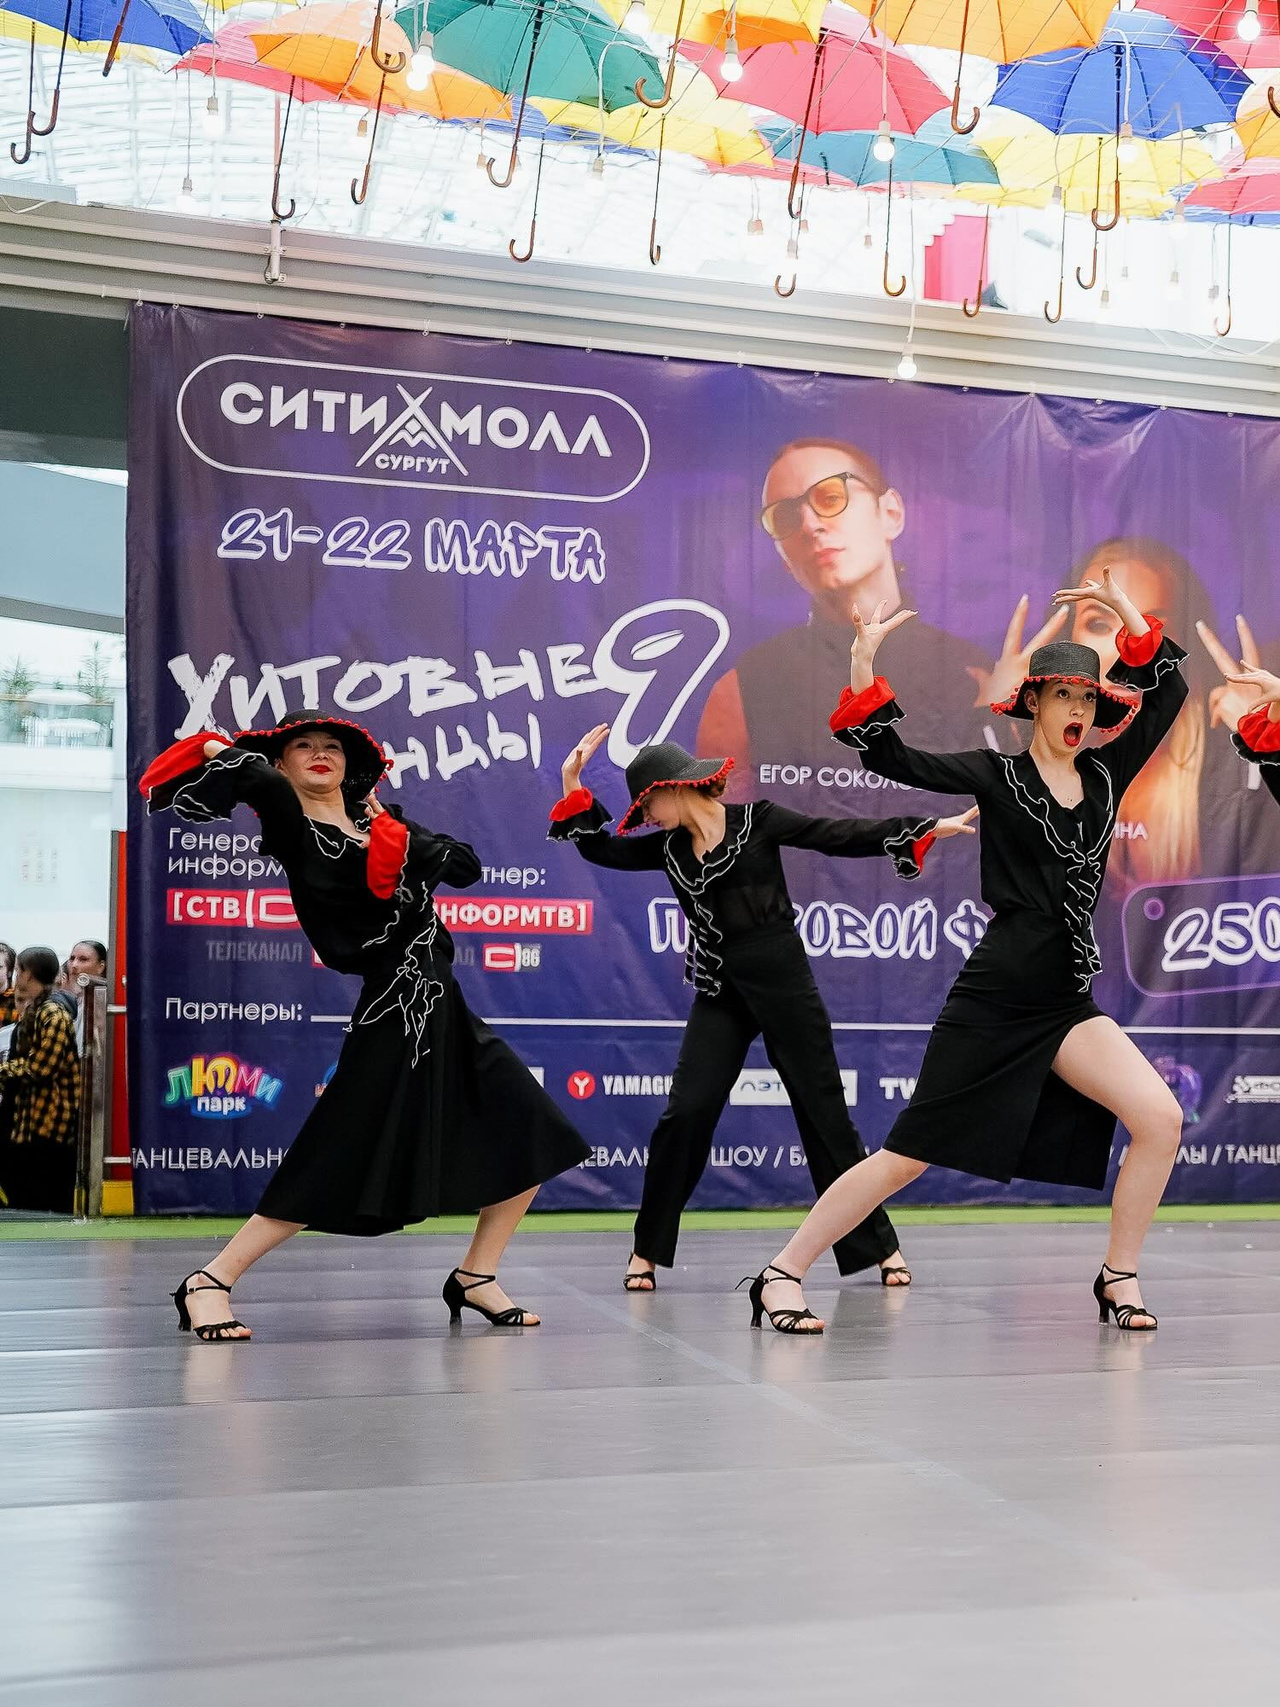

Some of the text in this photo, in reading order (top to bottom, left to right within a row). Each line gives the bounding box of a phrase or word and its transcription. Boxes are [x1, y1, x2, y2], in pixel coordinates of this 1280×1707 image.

[220, 381, 613, 458] СИТИ МОЛЛ
[375, 453, 451, 475] СУРГУТ
[217, 507, 607, 585] 21-22 МАРТА
[382, 711, 541, 790] НЦЫ
[759, 763, 923, 791] ЕГОР СОКОЛ
[168, 852, 547, 890] информ тнер:
[206, 939, 303, 963] ТЕЛЕКАНАЛ
[165, 997, 303, 1025] Партнеры:
[602, 1074, 674, 1096] YAMAGU
[197, 1095, 247, 1116] парк
[710, 1145, 769, 1167] ШОУ
[1175, 1144, 1208, 1165] ЛЫ
